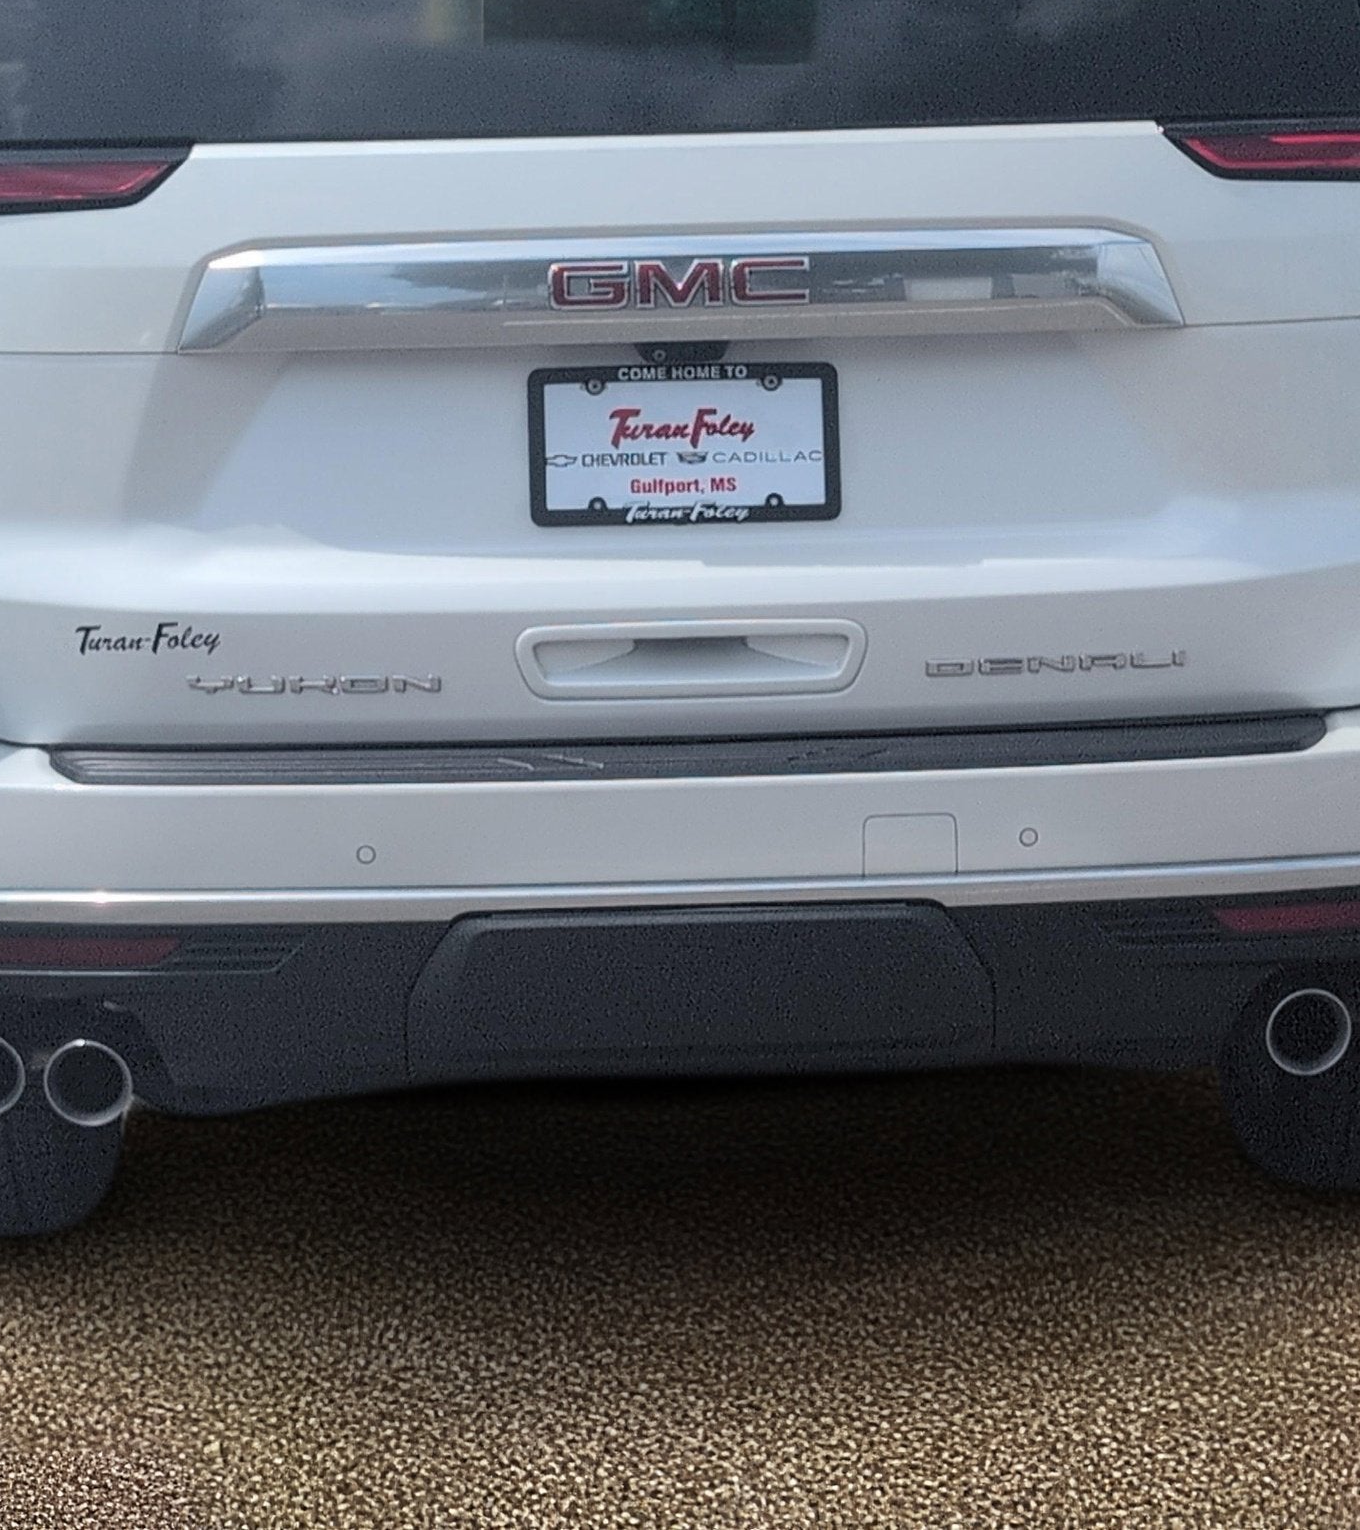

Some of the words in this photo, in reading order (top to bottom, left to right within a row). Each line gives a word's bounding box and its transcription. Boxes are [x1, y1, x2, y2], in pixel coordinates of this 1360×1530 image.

[548, 256, 810, 310] GMC
[617, 366, 667, 381] COME
[671, 365, 721, 380] HOME
[724, 364, 748, 379] TO
[581, 451, 668, 468] CHEVROLET
[712, 450, 823, 465] CADILLAC
[630, 478, 706, 496] Gulfport,
[710, 477, 737, 493] MS
[925, 650, 1185, 677] DENALI
[186, 673, 443, 695] YUKON
